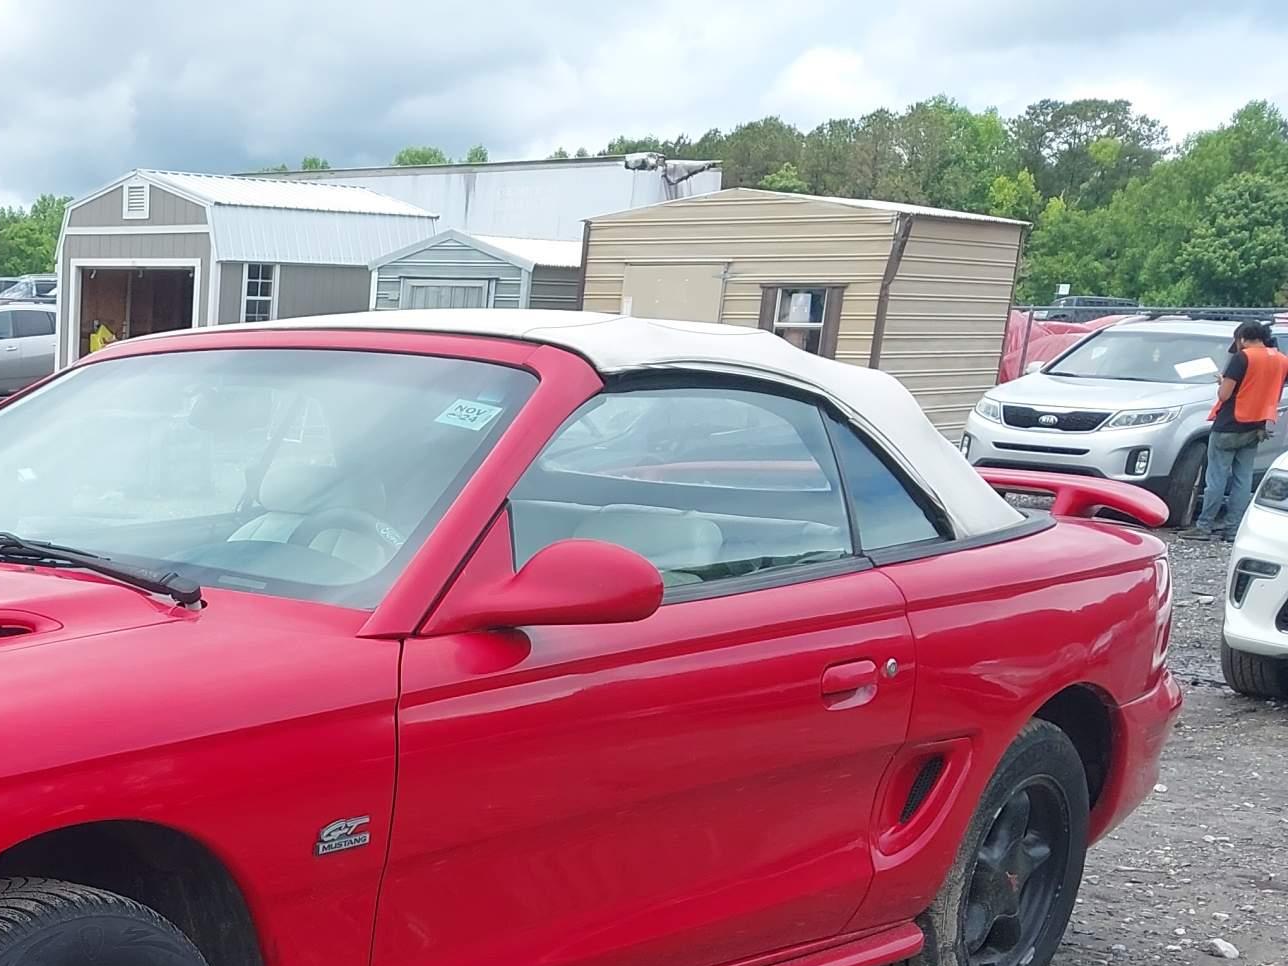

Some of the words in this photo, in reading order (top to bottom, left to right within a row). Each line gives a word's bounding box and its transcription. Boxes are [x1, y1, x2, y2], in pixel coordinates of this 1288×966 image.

[454, 404, 487, 416] NOV
[1040, 415, 1058, 426] KIA
[320, 815, 370, 842] GT
[321, 835, 367, 852] MUSTANG
